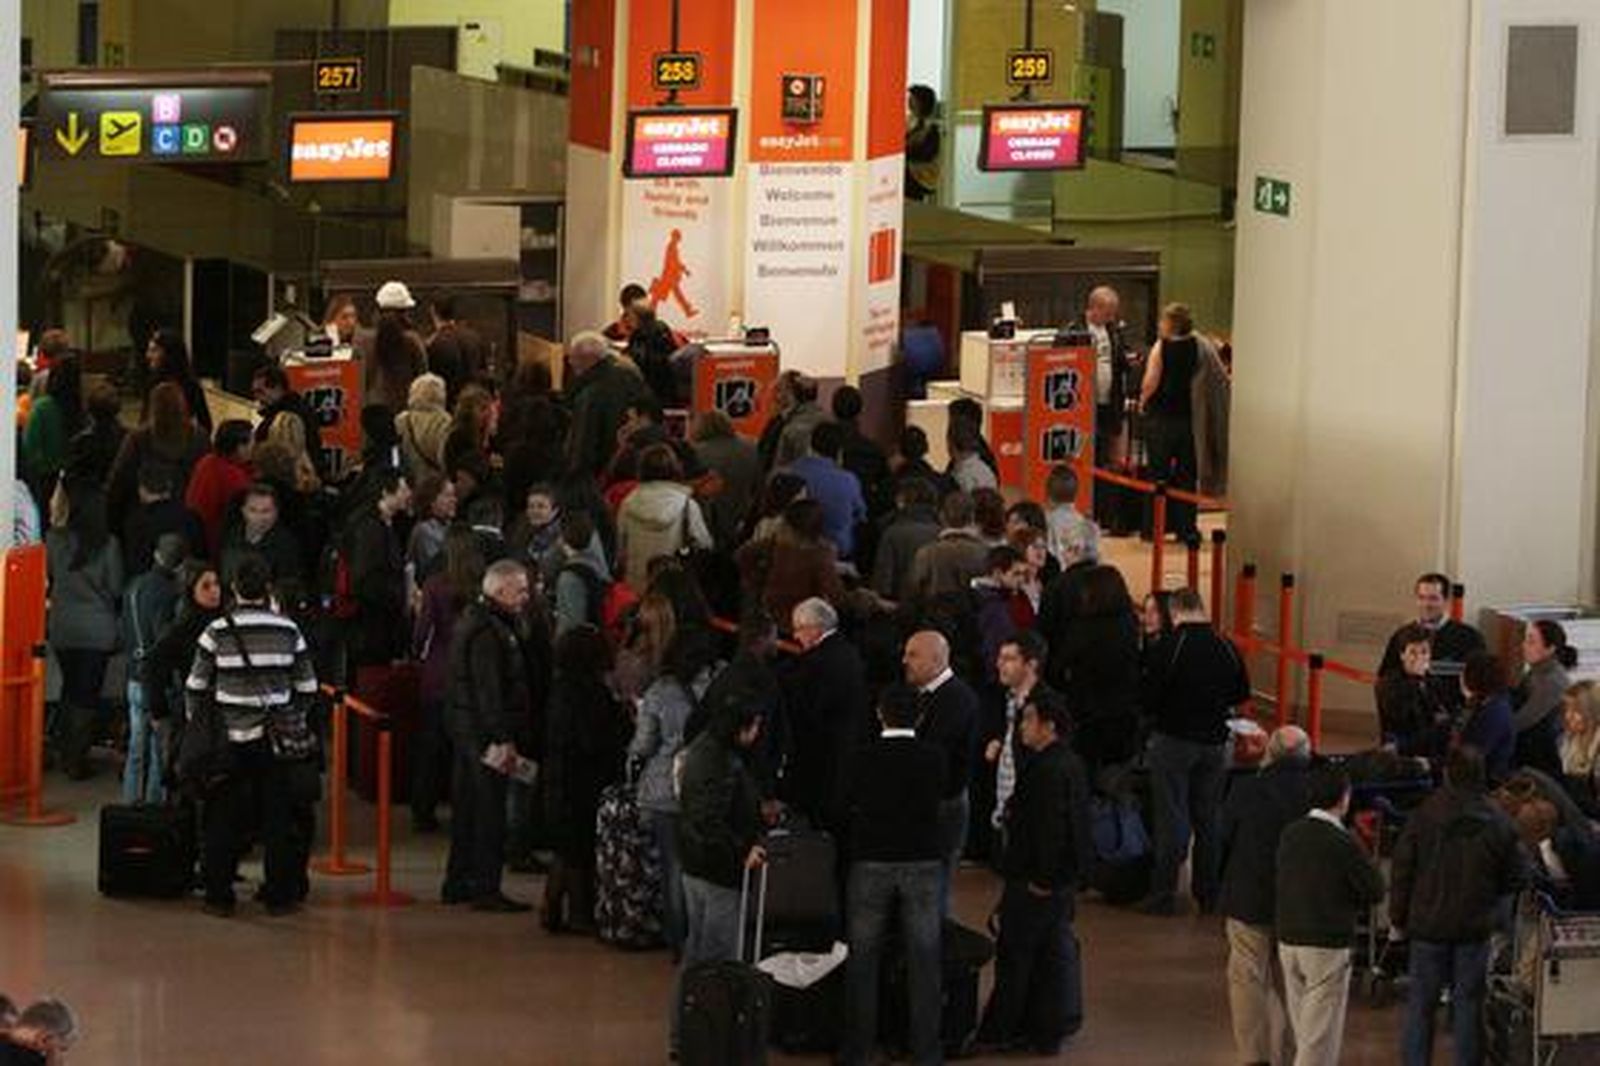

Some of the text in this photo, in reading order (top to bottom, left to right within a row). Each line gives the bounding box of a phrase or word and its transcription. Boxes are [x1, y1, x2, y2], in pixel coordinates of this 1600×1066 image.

[319, 66, 356, 87] 257
[1013, 58, 1047, 78] 259
[158, 127, 204, 151] C D
[291, 138, 391, 163] easyJet
[765, 188, 834, 201] Welcome
[753, 239, 844, 252] Willkommen
